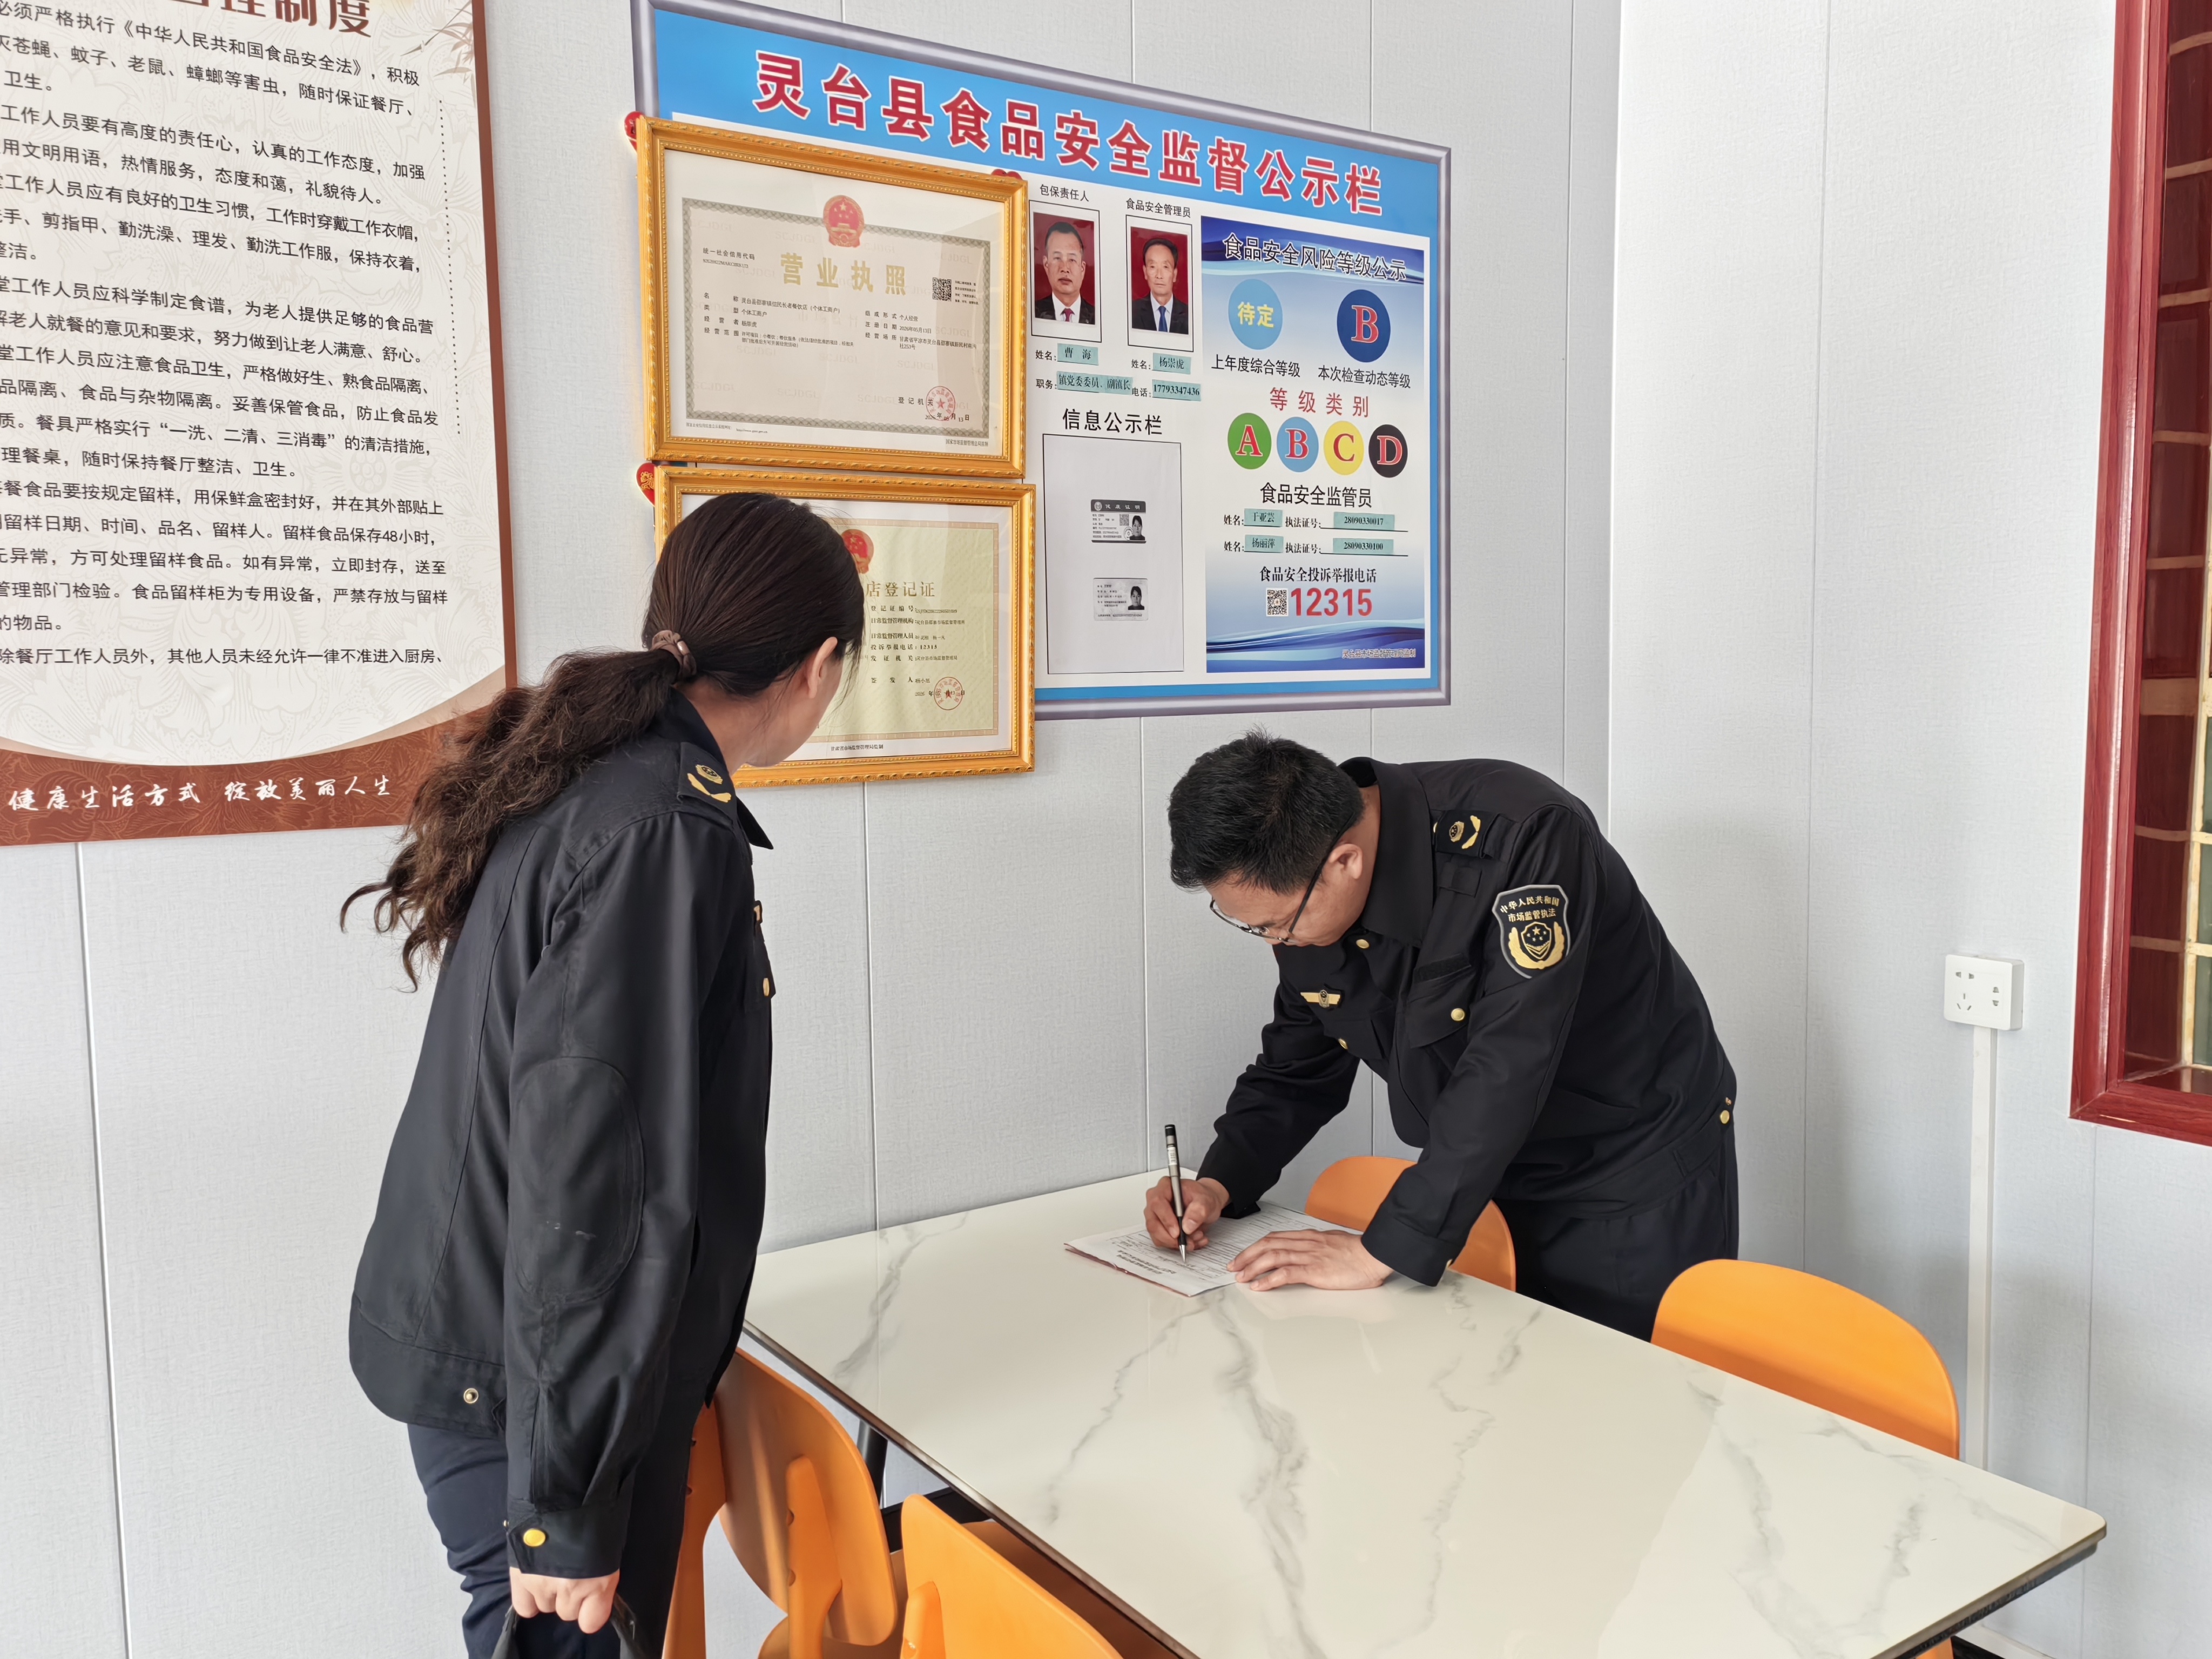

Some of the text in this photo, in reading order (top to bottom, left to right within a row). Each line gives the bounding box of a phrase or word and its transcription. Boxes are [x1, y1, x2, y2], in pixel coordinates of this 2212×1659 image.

[174, 0, 372, 38] 制度
[4, 70, 52, 91] 卫生。
[754, 50, 1382, 218] 灵台县食品安全监督公示栏
[0, 173, 419, 242] 工作人员应有良好的卫生习惯，工作时穿戴工作衣帽，
[1040, 184, 1089, 203] 包保责任人
[1126, 198, 1191, 218] 食品安全管理员
[0, 208, 421, 273] 手、剪指甲、勤洗澡、理发、勤洗工作服，保持衣着，
[703, 247, 755, 260] 统一社会信用代码
[1223, 233, 1406, 282] 食品安全风险等级公示
[780, 252, 906, 297] 营业执照
[1237, 301, 1274, 328] 待定
[1351, 305, 1379, 344] B
[1159, 355, 1185, 370] 杨崇虎
[1211, 354, 1411, 389] 上年度综合等级 本次检查动态等级
[1153, 384, 1200, 396] 17793347436
[1270, 387, 1370, 418] 等级类别
[1062, 408, 1163, 435] 信息公示栏
[1236, 424, 1263, 457] A
[1285, 428, 1310, 459] B
[1333, 433, 1355, 462] C
[1377, 435, 1403, 466] D
[0, 480, 444, 516] 餐食品要按规定留样，用保鲜盒密封好，并在其外部贴上
[1260, 482, 1373, 508] 食品安全监管员
[0, 514, 436, 545] 留样日期、时间、品名、留样人。留样食品保存48小时，
[1344, 516, 1384, 526] 28090330017
[1343, 541, 1384, 551] 28090330100
[1259, 565, 1377, 583] 食品安全投诉举报电话
[866, 581, 935, 597] 店登记证
[1291, 587, 1373, 617] 12315
[1342, 648, 1417, 659] 灵台县市场监督管理局监制
[9, 774, 390, 811] 健康生活方式 绽放美丽人生
[1500, 895, 1560, 915] 中华人民共和国
[1508, 908, 1556, 923] 市场监管执法
